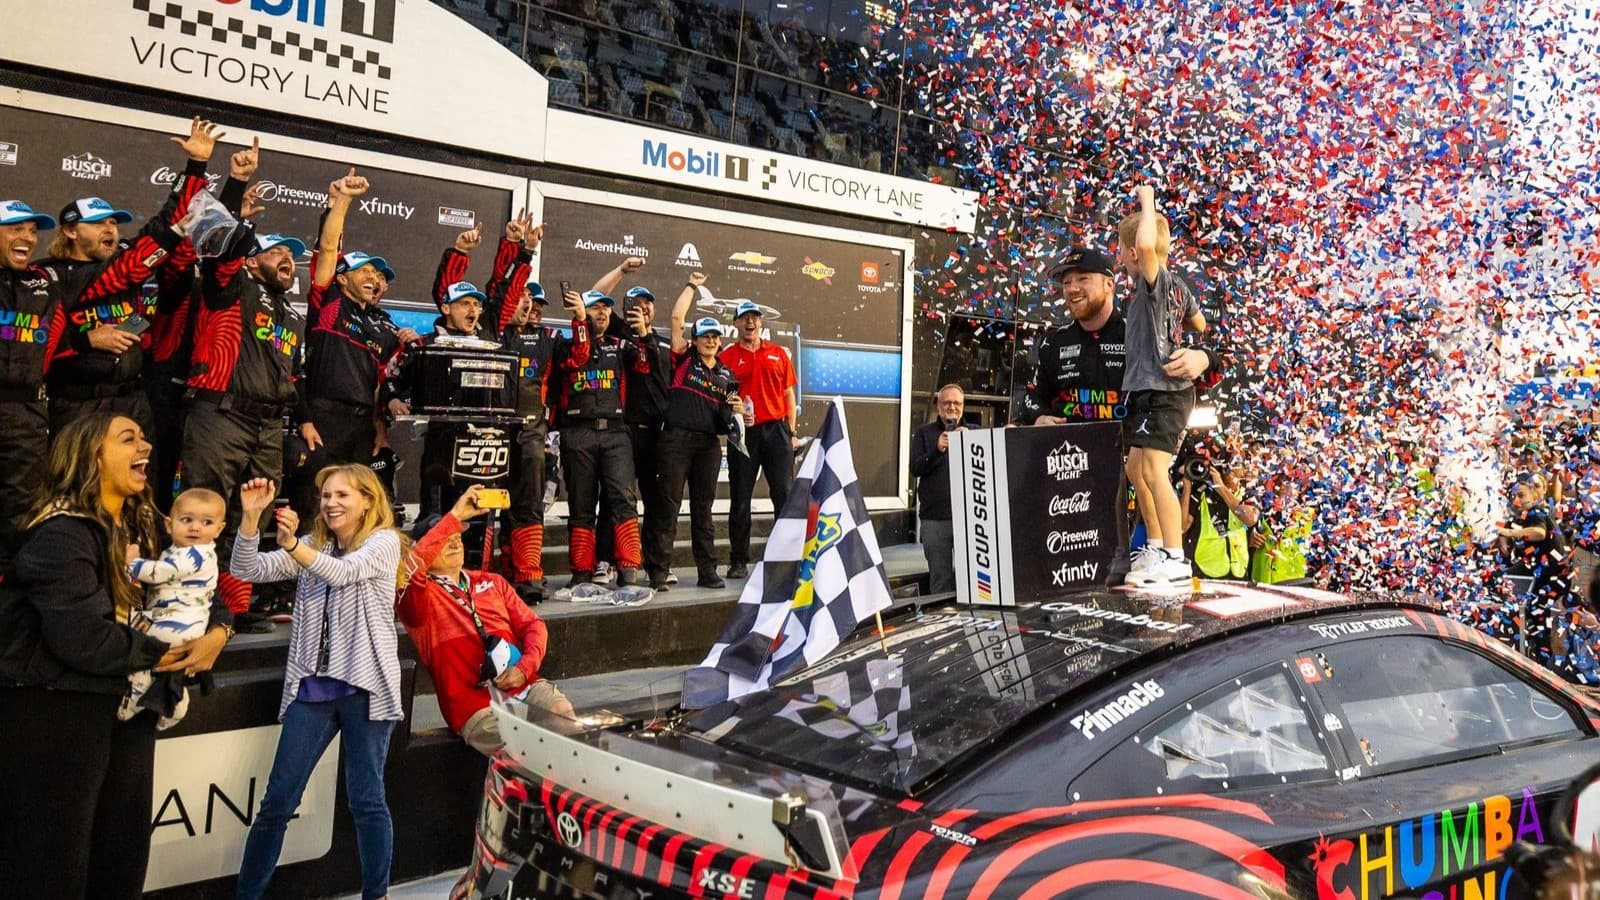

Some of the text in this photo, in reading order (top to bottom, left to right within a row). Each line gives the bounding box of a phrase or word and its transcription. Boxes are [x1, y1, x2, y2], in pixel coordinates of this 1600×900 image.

[131, 36, 390, 114] VICTORY LANE
[61, 157, 112, 177] BUSCH
[642, 139, 742, 179] Mobil 1
[72, 171, 100, 180] LIGHT
[278, 184, 328, 204] Freeway
[788, 169, 924, 210] VICTORY LANE
[359, 197, 415, 220] xfinity
[575, 239, 649, 257] AdventHealth
[675, 259, 703, 268] AXALTA
[728, 265, 777, 275] CHEVROLET
[803, 266, 833, 276] SUNOCO
[857, 285, 882, 293] TOYOTA
[0, 310, 50, 329] UMBA
[71, 301, 135, 325] CHUMB
[0, 326, 47, 344] SINO
[255, 312, 298, 346] CHUMB
[256, 328, 295, 359] CASIN
[1100, 344, 1126, 352] TOYOT
[574, 380, 618, 392] CASINO
[1063, 402, 1129, 419] CASINO
[456, 447, 508, 466] 500
[1046, 452, 1089, 475] BUSCH
[1056, 471, 1081, 481] LIGHT
[971, 443, 990, 569] CUP SERIES
[1062, 529, 1098, 543] Freeway
[1063, 540, 1099, 552] INSURANCE
[1052, 560, 1099, 587] xfinity
[1331, 621, 1369, 636] TYLER
[1364, 616, 1413, 630] REDDICK
[1070, 678, 1164, 740] Pinnacle
[930, 824, 977, 845] TOYOTA
[1307, 785, 1544, 900] CHUMBA
[699, 868, 756, 898] XSE
